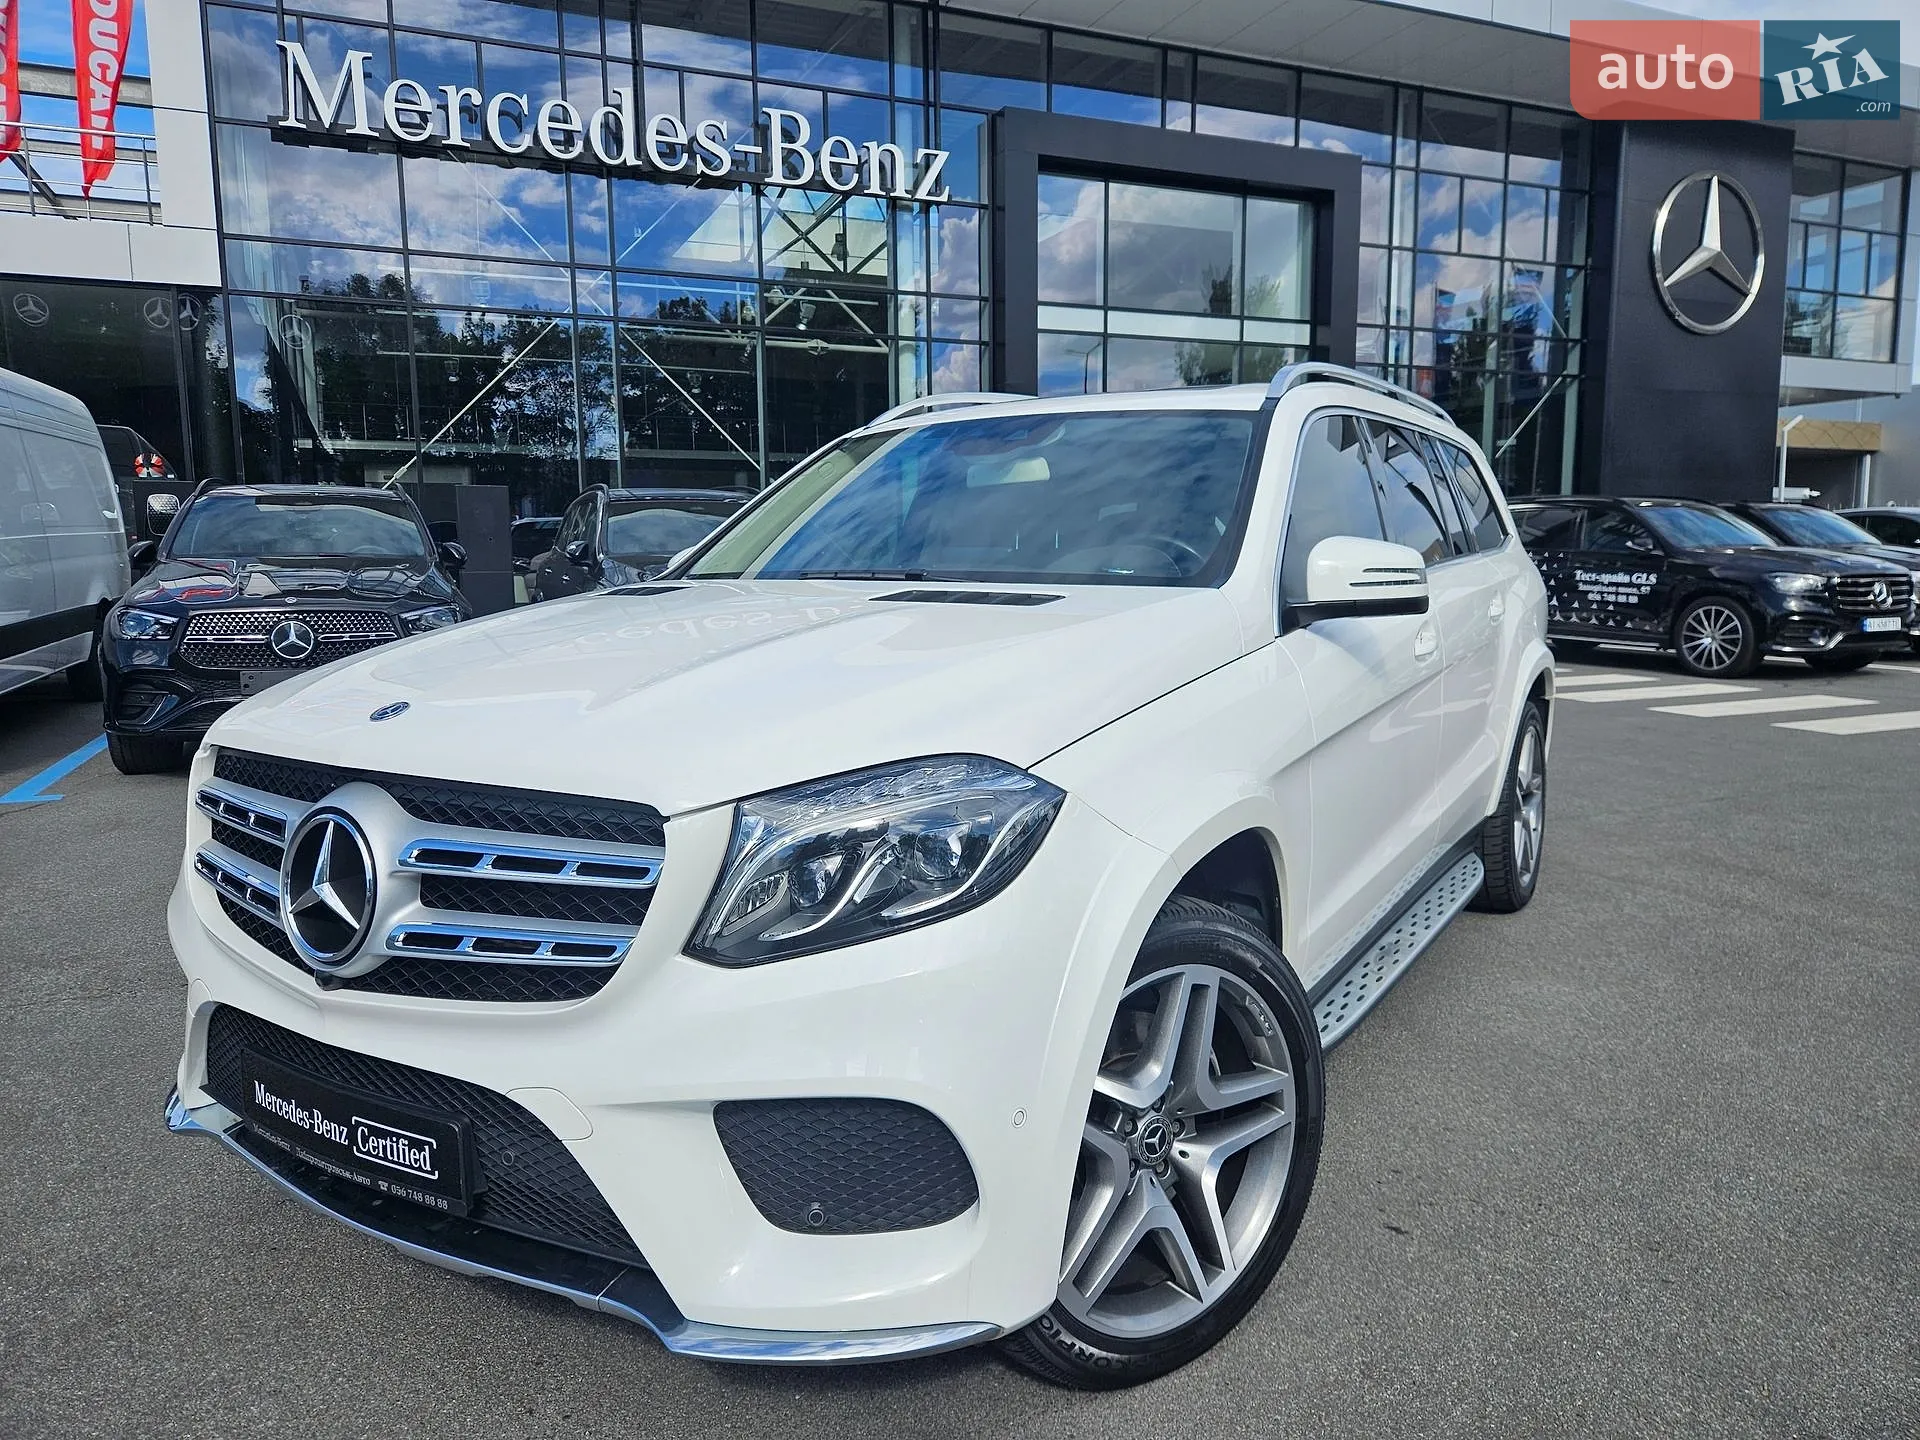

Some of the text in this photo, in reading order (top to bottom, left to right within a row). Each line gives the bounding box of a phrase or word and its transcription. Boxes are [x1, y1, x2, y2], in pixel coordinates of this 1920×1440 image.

[275, 39, 950, 202] Mercedes-Benz
[1631, 573, 1657, 585] GLS
[254, 1080, 431, 1171] Mercedes-Benz Certified
